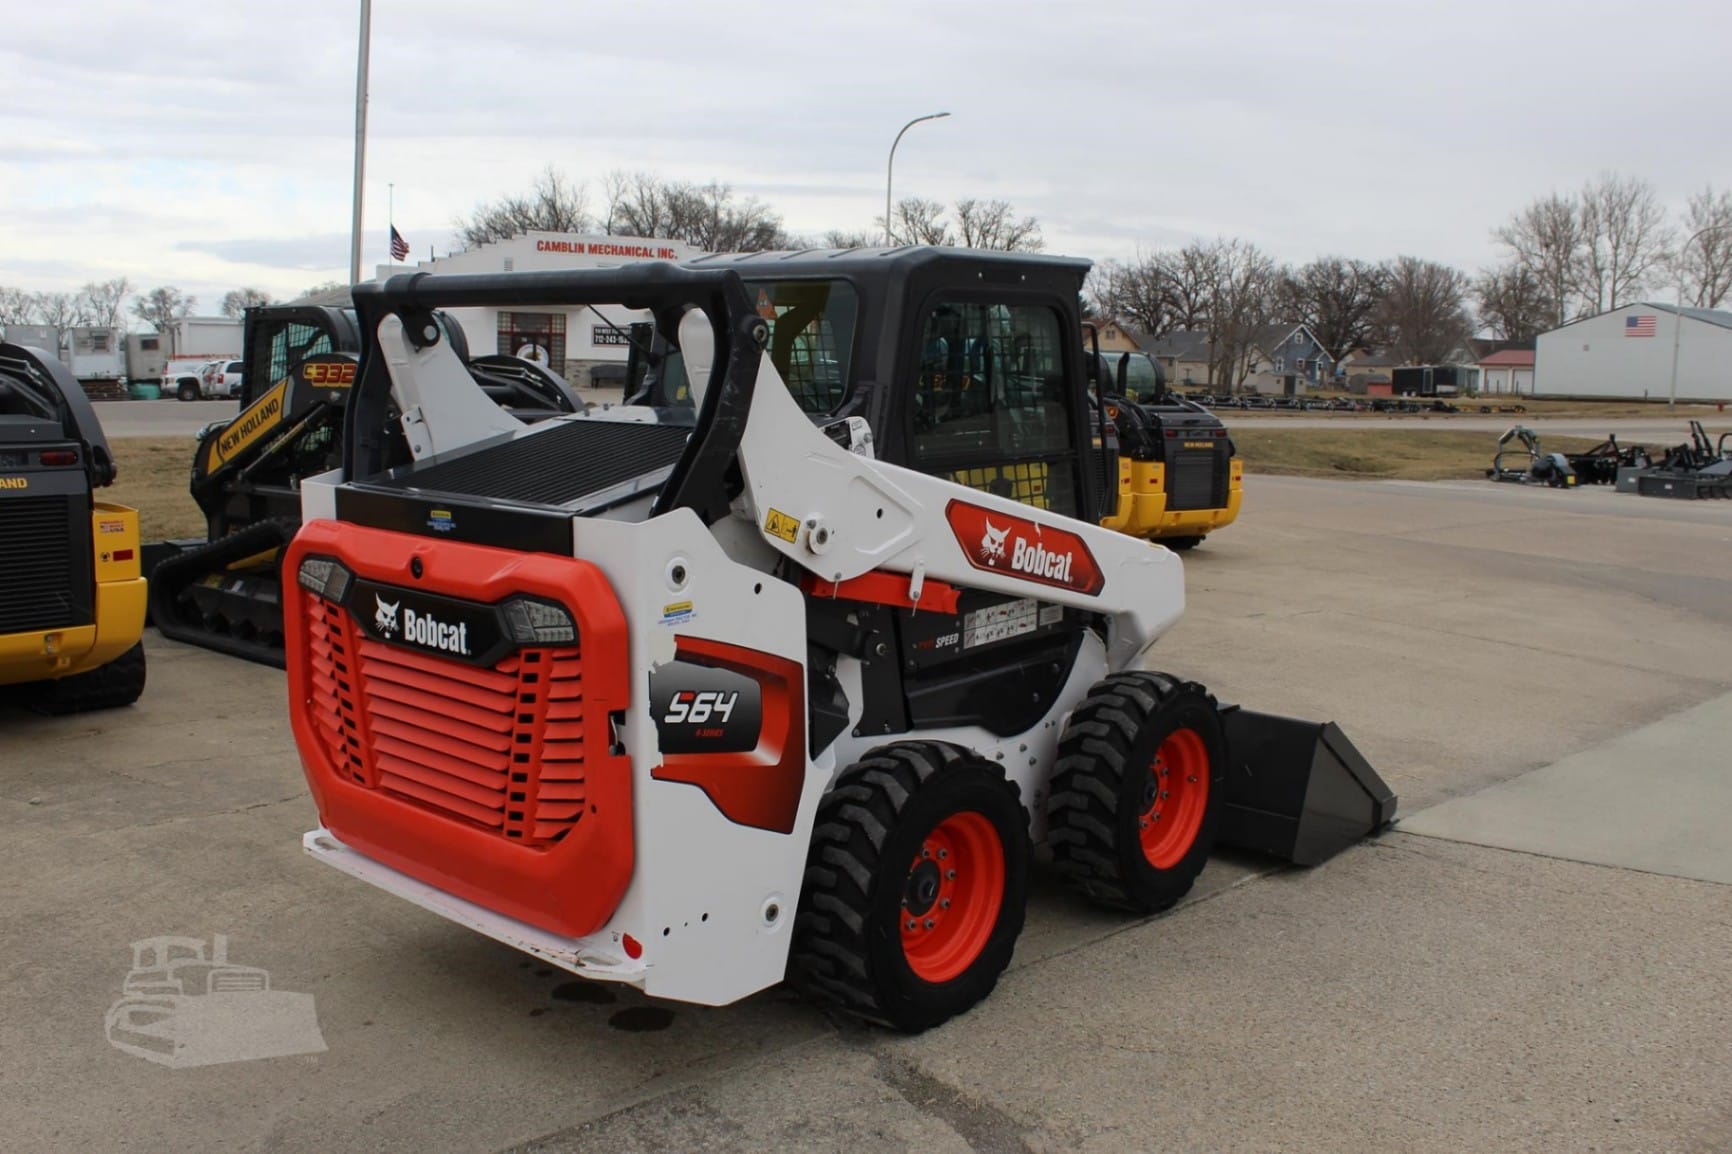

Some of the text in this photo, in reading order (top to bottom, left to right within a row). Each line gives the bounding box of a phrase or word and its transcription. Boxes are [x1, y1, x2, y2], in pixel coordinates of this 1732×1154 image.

[537, 240, 678, 260] CAMBLIN MECHANICAL INC.
[220, 398, 279, 455] NEW HOLLAND
[1011, 536, 1072, 582] Bobcat
[404, 608, 467, 655] Bobcat
[935, 632, 959, 649] SPEED
[664, 691, 739, 723] S64
